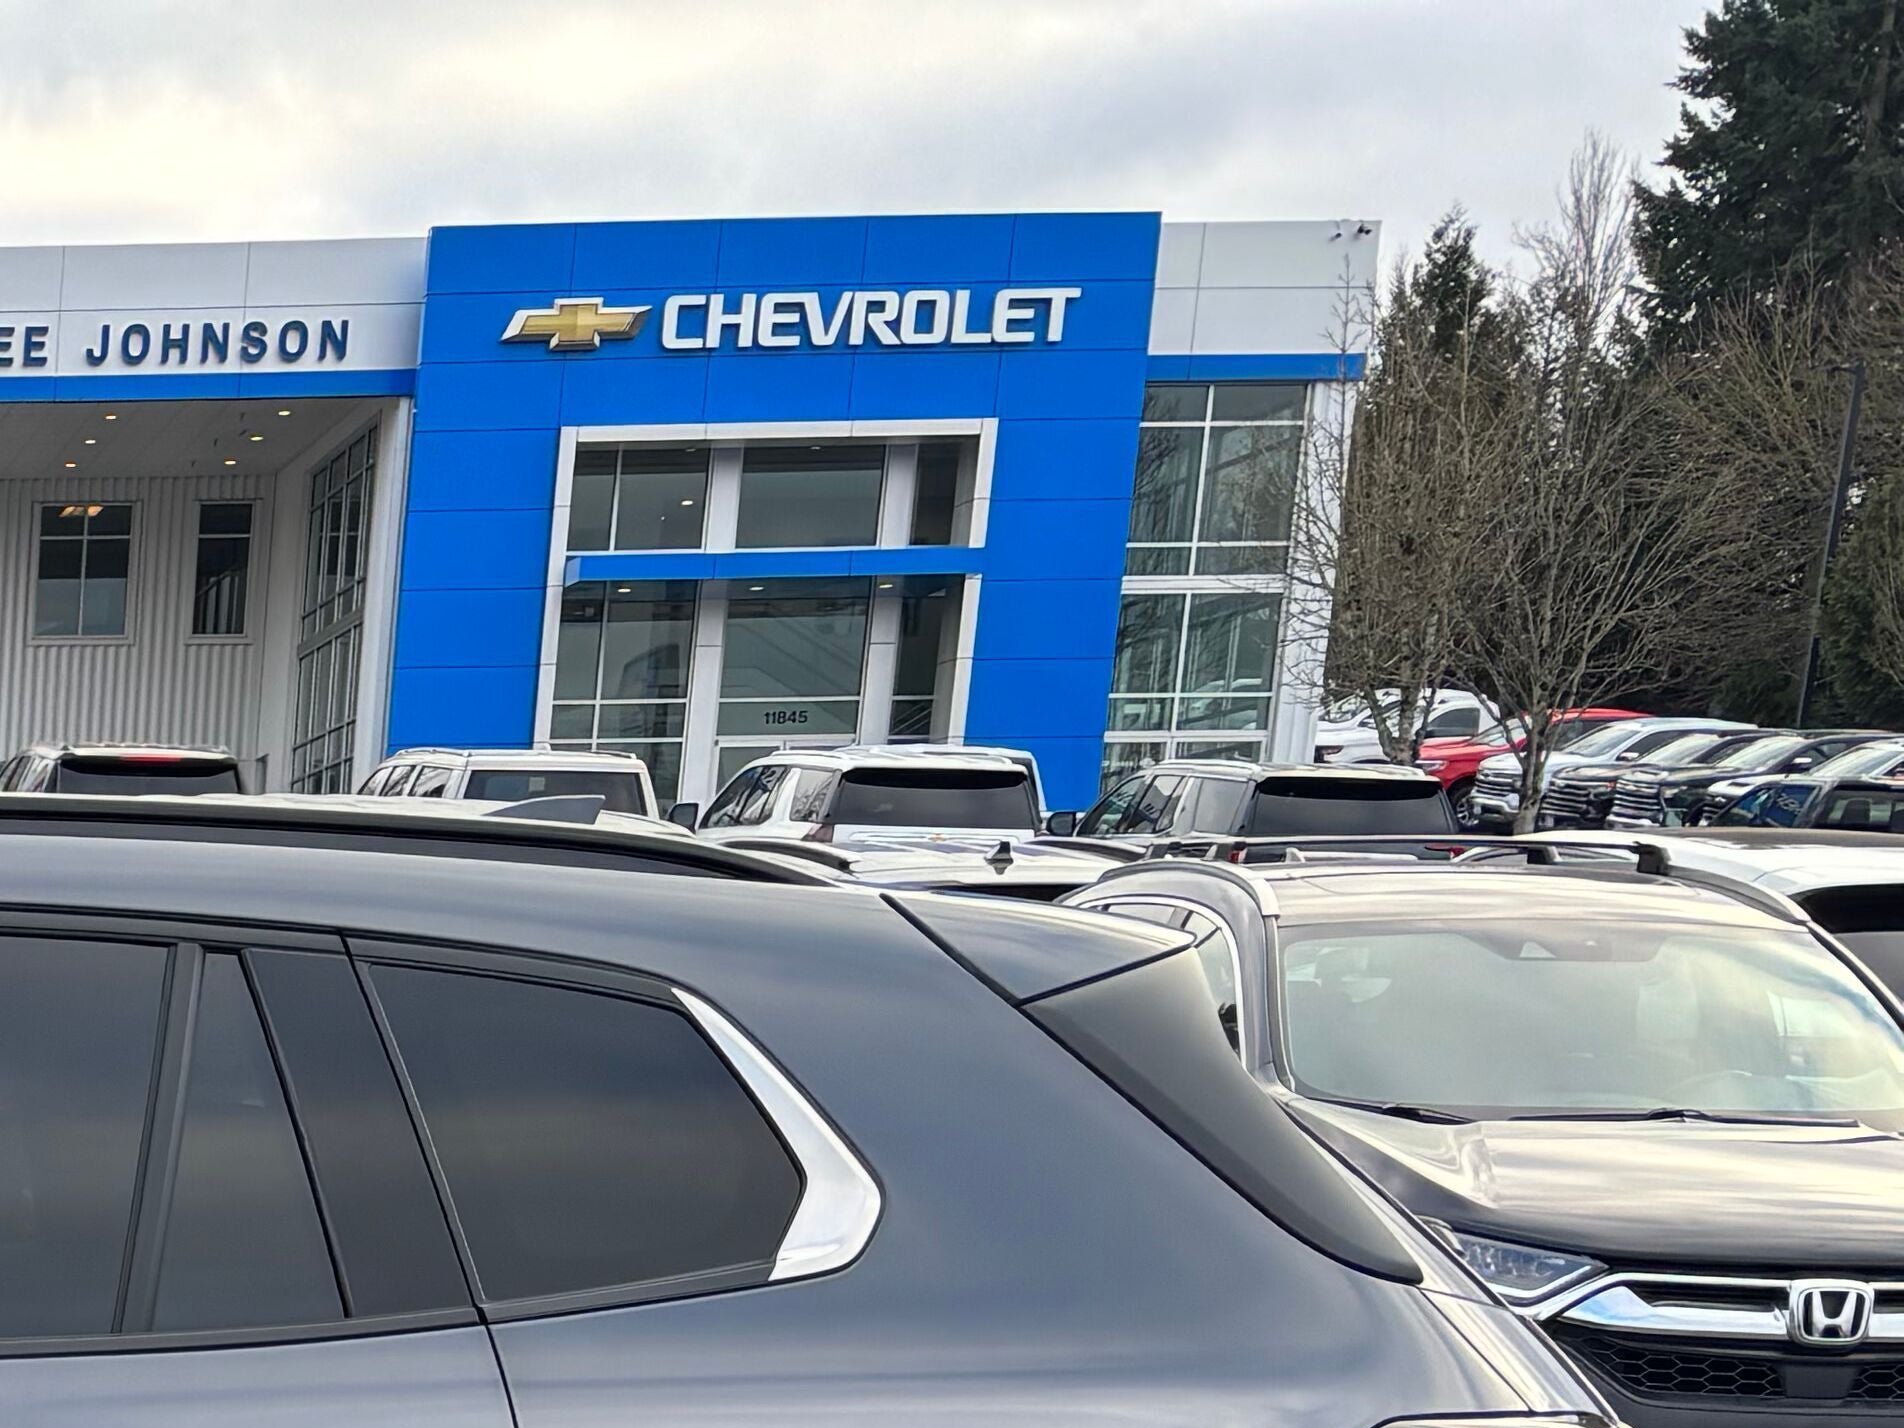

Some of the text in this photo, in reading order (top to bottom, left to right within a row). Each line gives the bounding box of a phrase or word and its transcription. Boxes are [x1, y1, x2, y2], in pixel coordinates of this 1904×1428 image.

[661, 287, 1082, 350] CHEVROLET
[85, 319, 350, 367] JOHNSON
[764, 710, 809, 724] 11845
